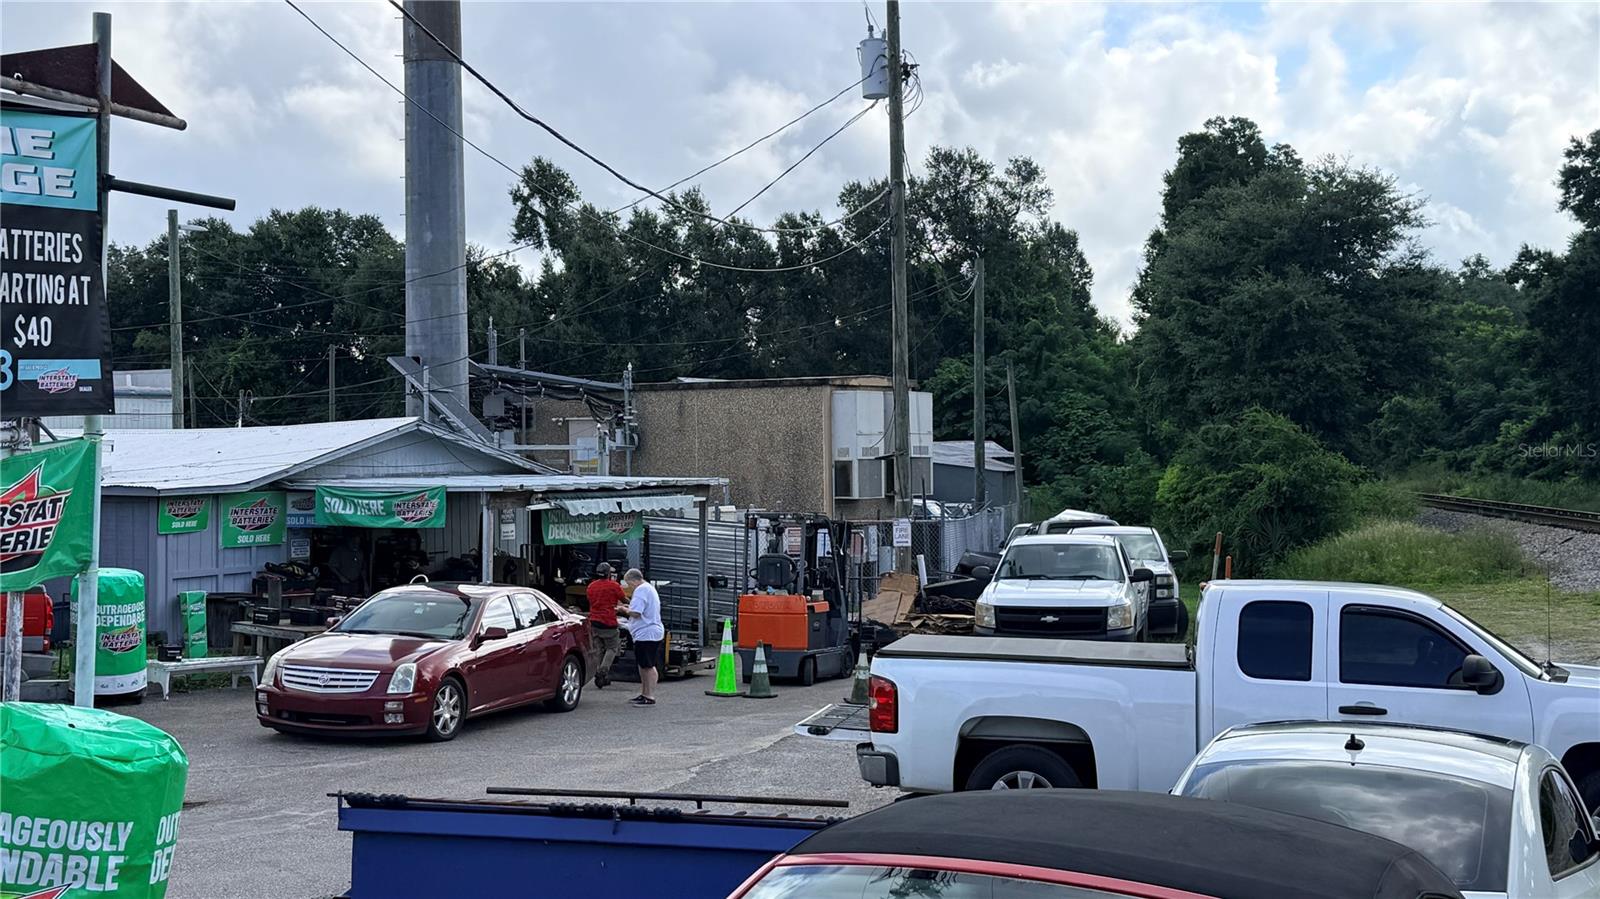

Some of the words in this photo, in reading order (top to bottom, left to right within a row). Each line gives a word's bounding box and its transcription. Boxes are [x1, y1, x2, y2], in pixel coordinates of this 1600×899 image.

[68, 276, 91, 305] AT
[14, 314, 52, 348] $40
[324, 496, 354, 515] SOLD
[354, 499, 386, 516] HERE
[393, 500, 437, 511] INTERSTATE
[230, 507, 278, 516] INTERSTATE
[172, 521, 185, 529] SOLD
[231, 516, 274, 525] BATTERIES
[287, 516, 305, 525] SOLD
[237, 535, 254, 543] SOLD
[255, 534, 271, 542] HERE
[0, 811, 134, 852] AGEOUSLY
